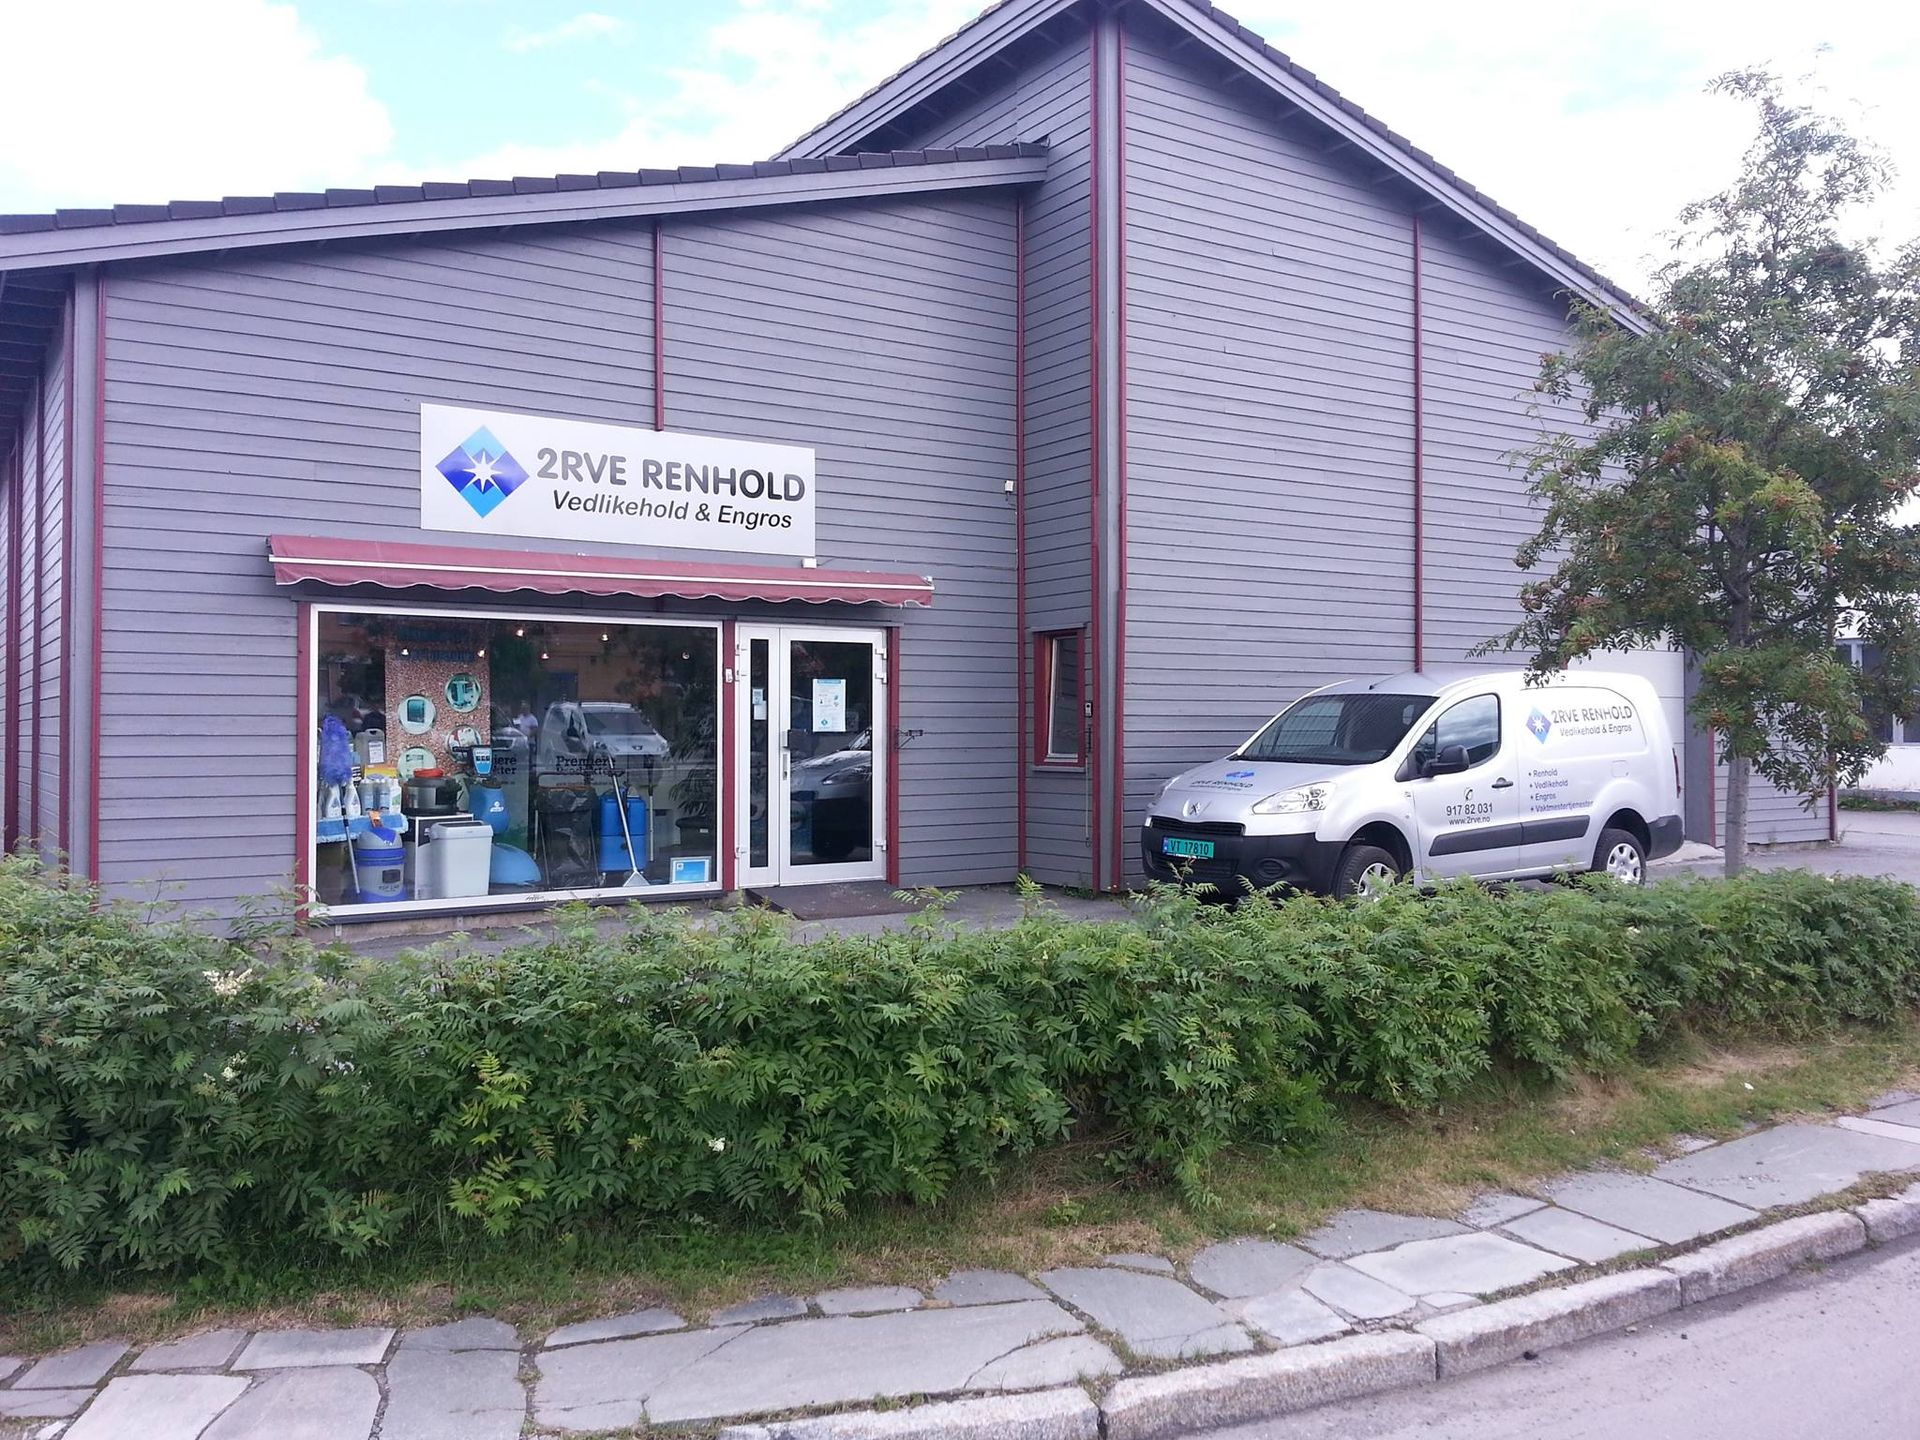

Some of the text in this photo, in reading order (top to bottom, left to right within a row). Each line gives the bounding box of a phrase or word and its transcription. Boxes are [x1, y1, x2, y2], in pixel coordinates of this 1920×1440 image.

[536, 447, 806, 502] 2RVE RENHOLD
[552, 490, 793, 531] Vedlikehold & Engros
[1551, 705, 1633, 724] 2RVE RENHOLD
[1560, 723, 1633, 737] Vedlikehold & Engros
[1533, 768, 1558, 777] Renhold
[1534, 779, 1569, 789] Vedlikehold
[1535, 793, 1557, 802] Engros
[1446, 802, 1493, 816] 917 82 031
[1448, 816, 1491, 825] www.2rve.no
[1170, 840, 1209, 855] VT 17810
